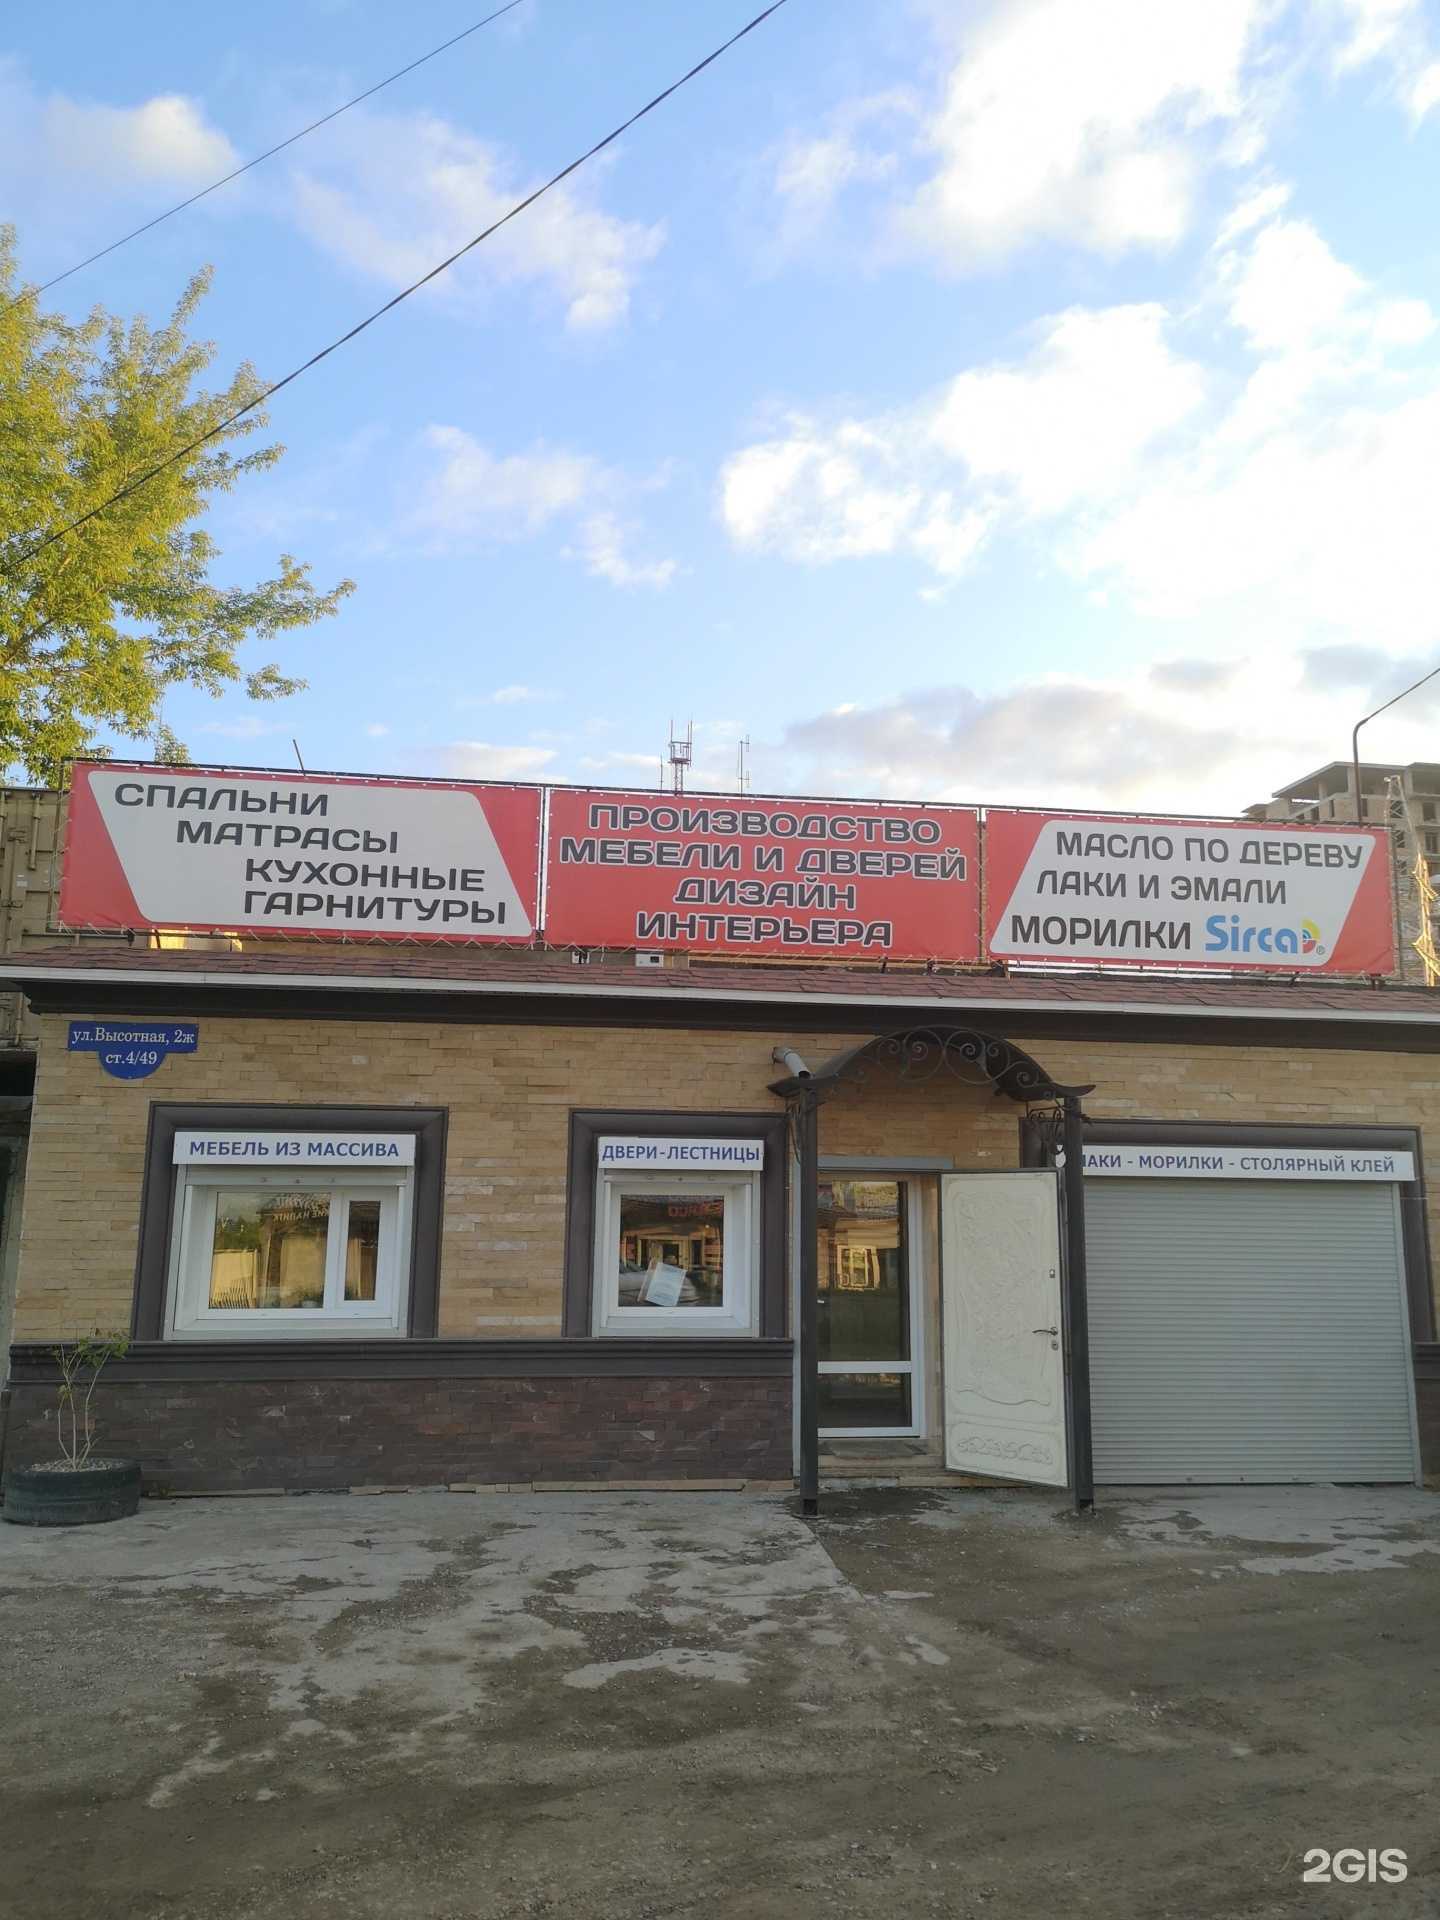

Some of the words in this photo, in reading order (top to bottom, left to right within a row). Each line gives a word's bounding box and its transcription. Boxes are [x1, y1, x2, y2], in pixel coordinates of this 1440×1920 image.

[114, 782, 329, 817] СПАЛЬНИ
[176, 820, 398, 854] МАТРАСЫ
[588, 803, 942, 844] ПРОИЗВОДСТВО
[559, 837, 741, 872] МЕБЕЛИ
[754, 845, 785, 872] И
[795, 847, 967, 882] ДВЕРЕЙ
[1056, 831, 1174, 861] МАСЛО
[1184, 838, 1230, 864] ПО
[1239, 840, 1364, 869] ДЕРЕВУ
[245, 858, 486, 892] КУХОННЫЕ
[1036, 869, 1127, 898] ЛАКИ
[1138, 874, 1160, 900] И
[1170, 875, 1287, 905] ЭМАЛИ
[243, 890, 505, 925] ГАРНИТУРЫ
[672, 876, 857, 911] ДИЗАЙН
[635, 911, 893, 948] ИНТЕРЬЕРА
[1011, 914, 1192, 950] МОРИЛКИ
[1205, 914, 1299, 954] Sirca
[173, 1029, 195, 1044] 2ж
[105, 1051, 158, 1066] ст.4/49
[189, 1140, 270, 1156] МЕБЕЛЬ
[275, 1141, 301, 1156] ИЗ
[306, 1142, 400, 1157] МАССИВА
[1138, 1155, 1224, 1170] МОРИЛКИ
[1239, 1155, 1345, 1173] СТОЛЯРНЫЙ
[1350, 1156, 1395, 1173] КЛЕЙ
